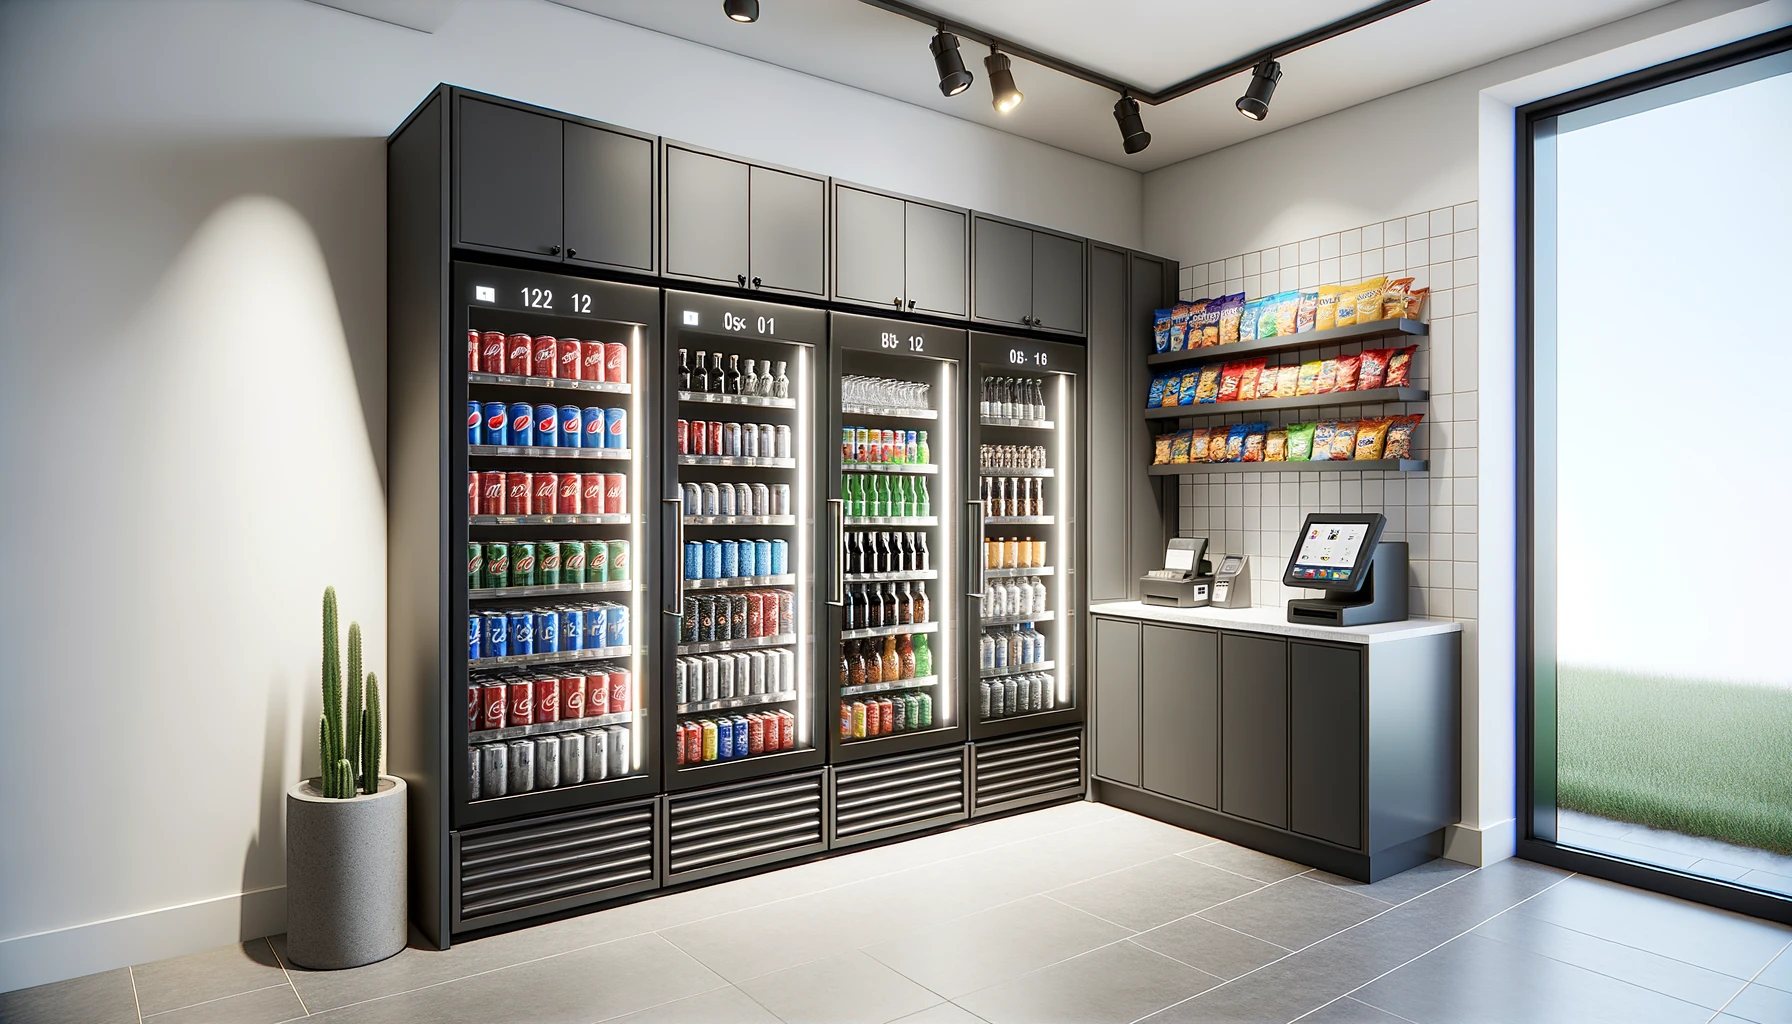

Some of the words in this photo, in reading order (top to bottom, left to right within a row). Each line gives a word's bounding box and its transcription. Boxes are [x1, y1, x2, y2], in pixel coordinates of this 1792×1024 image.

[521, 287, 553, 309] 122
[571, 293, 592, 313] 12
[757, 316, 775, 335] 01
[908, 336, 924, 352] 12
